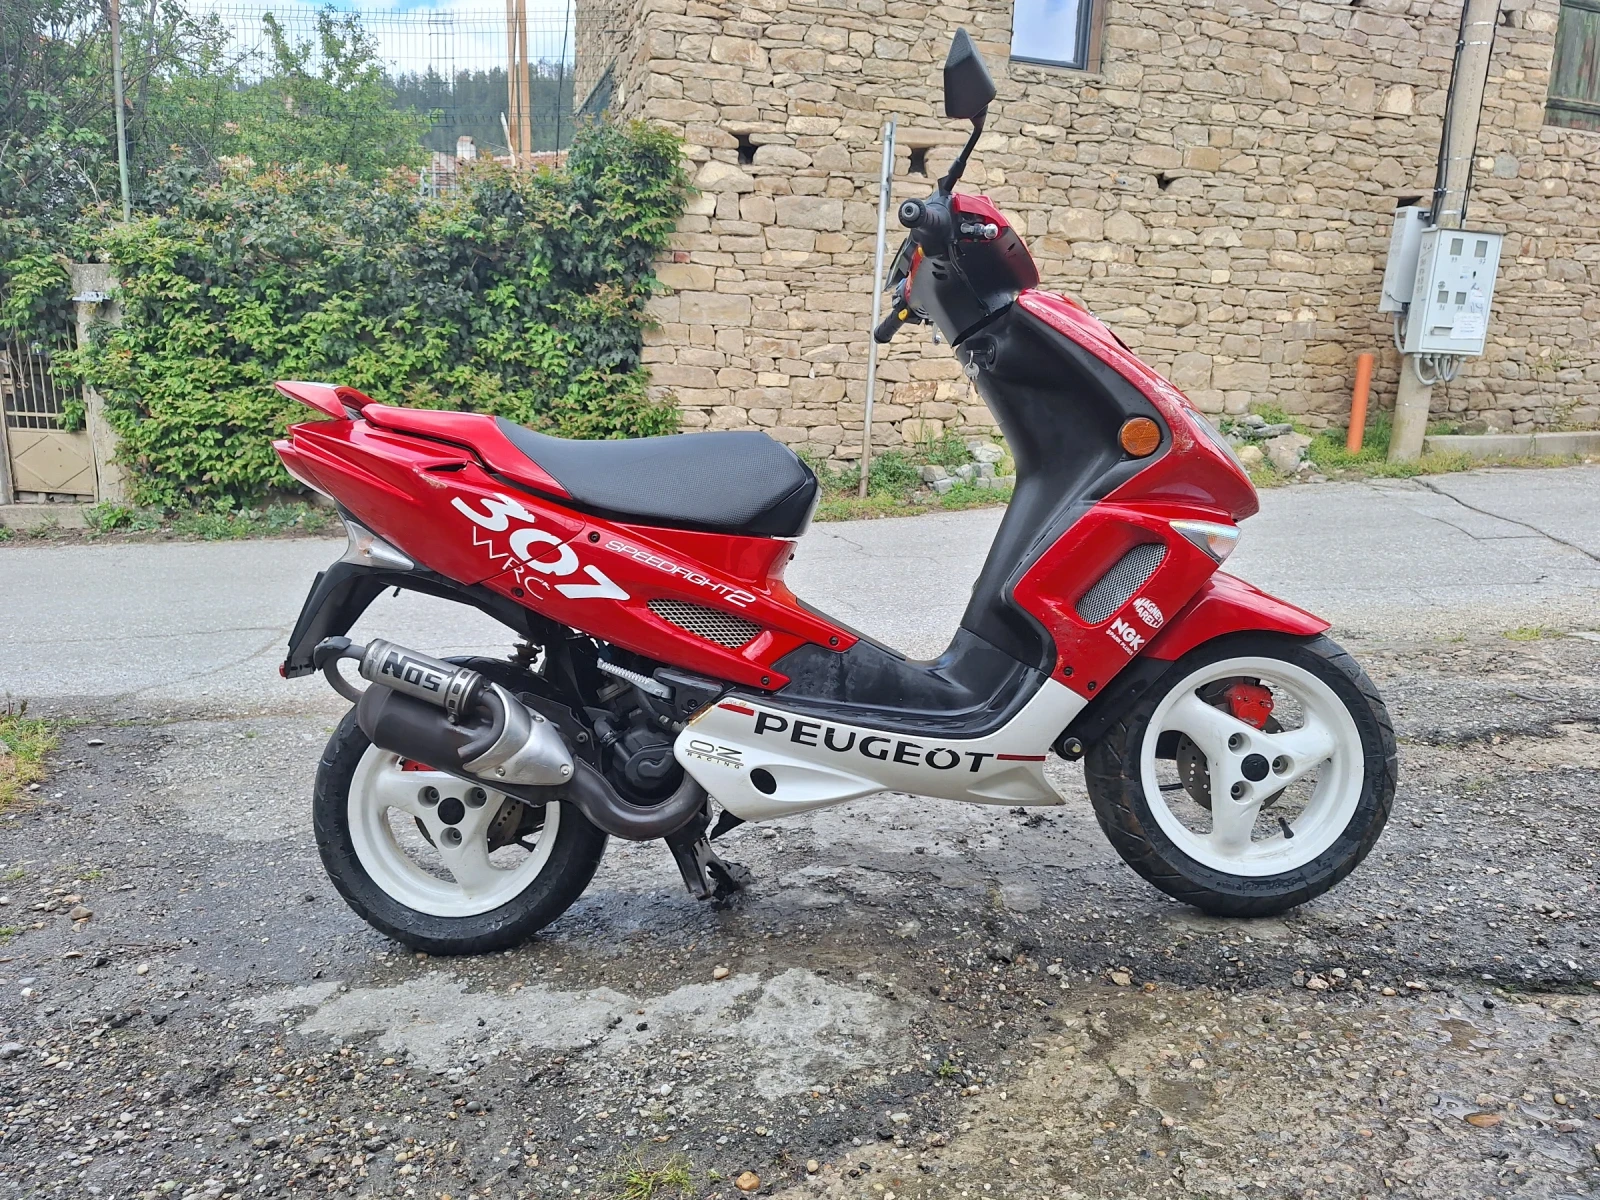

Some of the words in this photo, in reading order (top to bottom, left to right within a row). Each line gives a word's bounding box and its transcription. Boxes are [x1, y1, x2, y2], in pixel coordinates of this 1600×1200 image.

[450, 493, 631, 600] 307
[473, 525, 551, 600] WRC
[1105, 629, 1123, 645] SPARK
[1110, 616, 1146, 651] NGK
[381, 650, 455, 693] NOS
[686, 752, 740, 769] RACING
[753, 711, 994, 773] PEUGEOT
